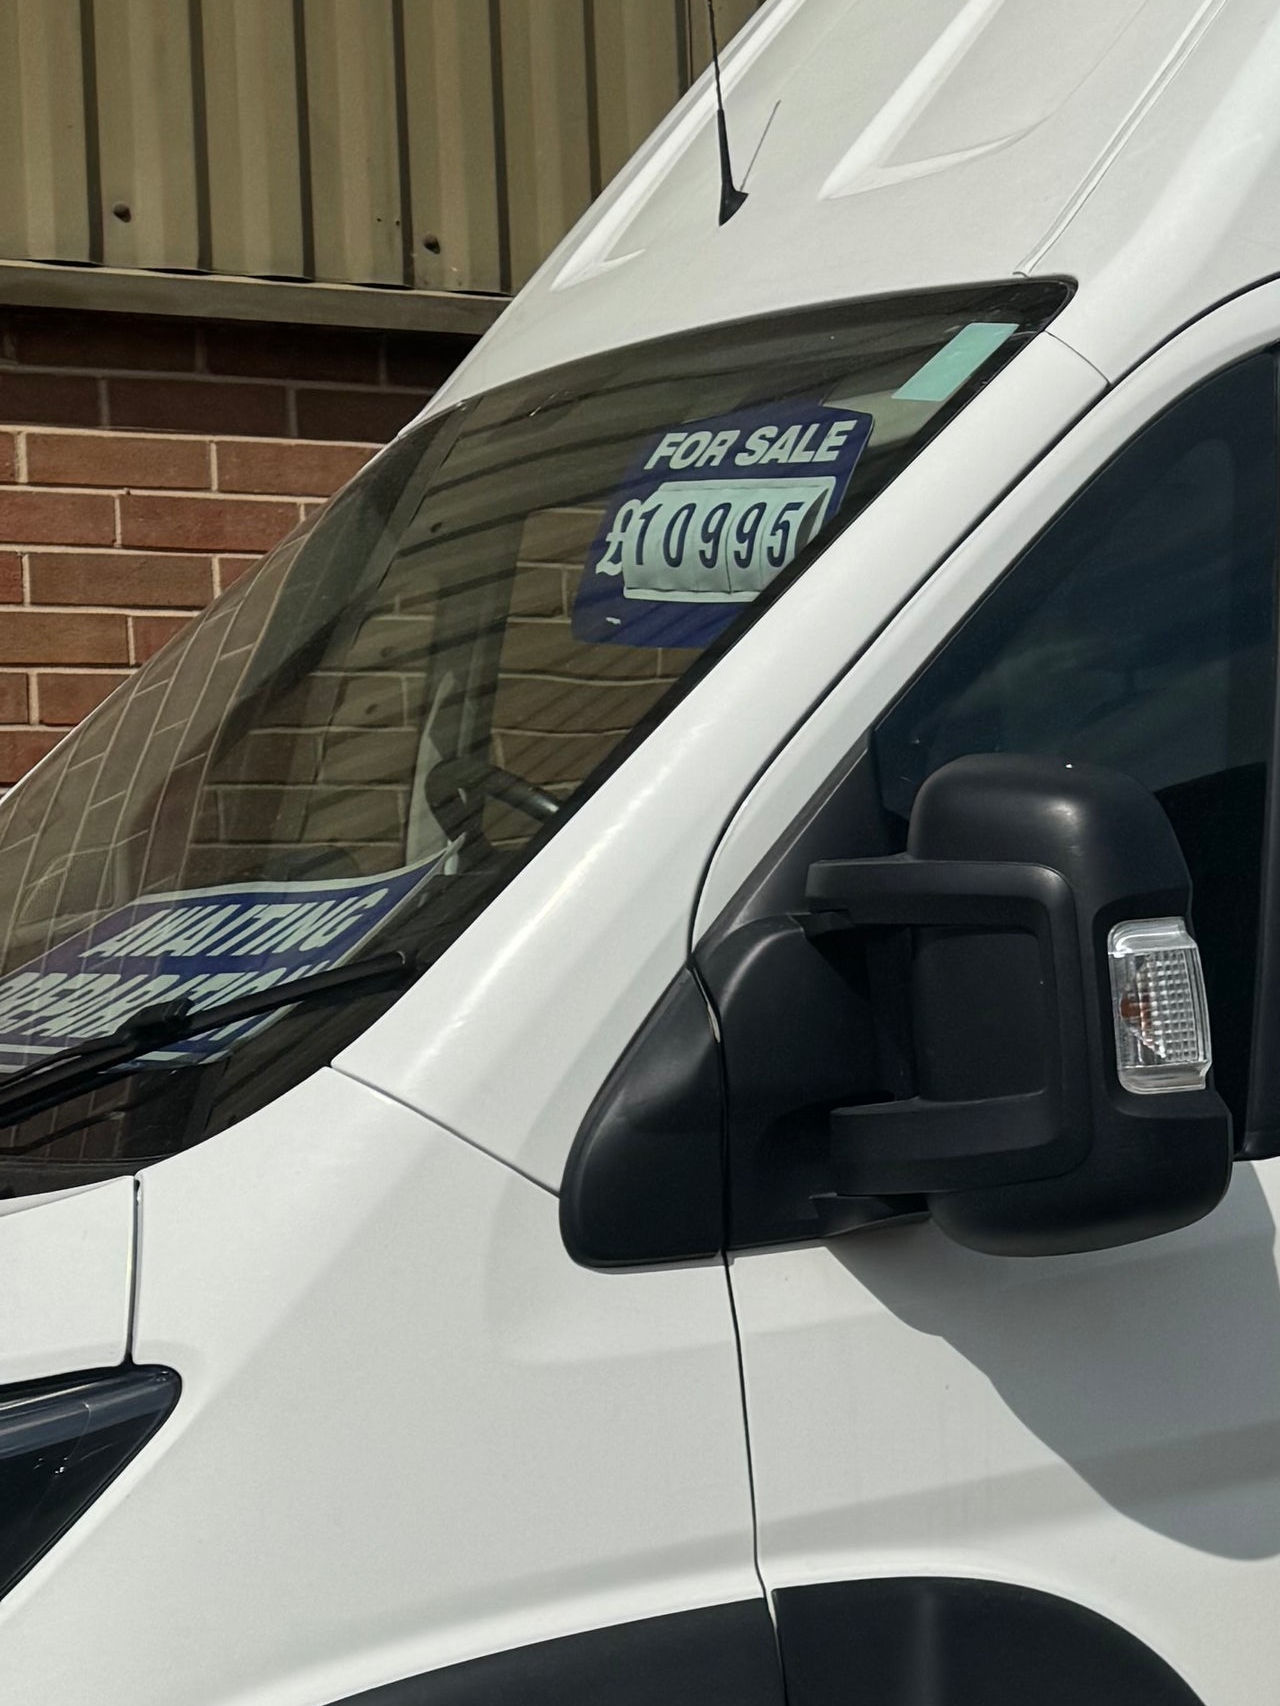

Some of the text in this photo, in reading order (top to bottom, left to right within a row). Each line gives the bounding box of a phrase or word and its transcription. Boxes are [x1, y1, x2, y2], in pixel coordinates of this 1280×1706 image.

[643, 418, 859, 471] FOR SALE
[79, 887, 389, 958] AWAITING
